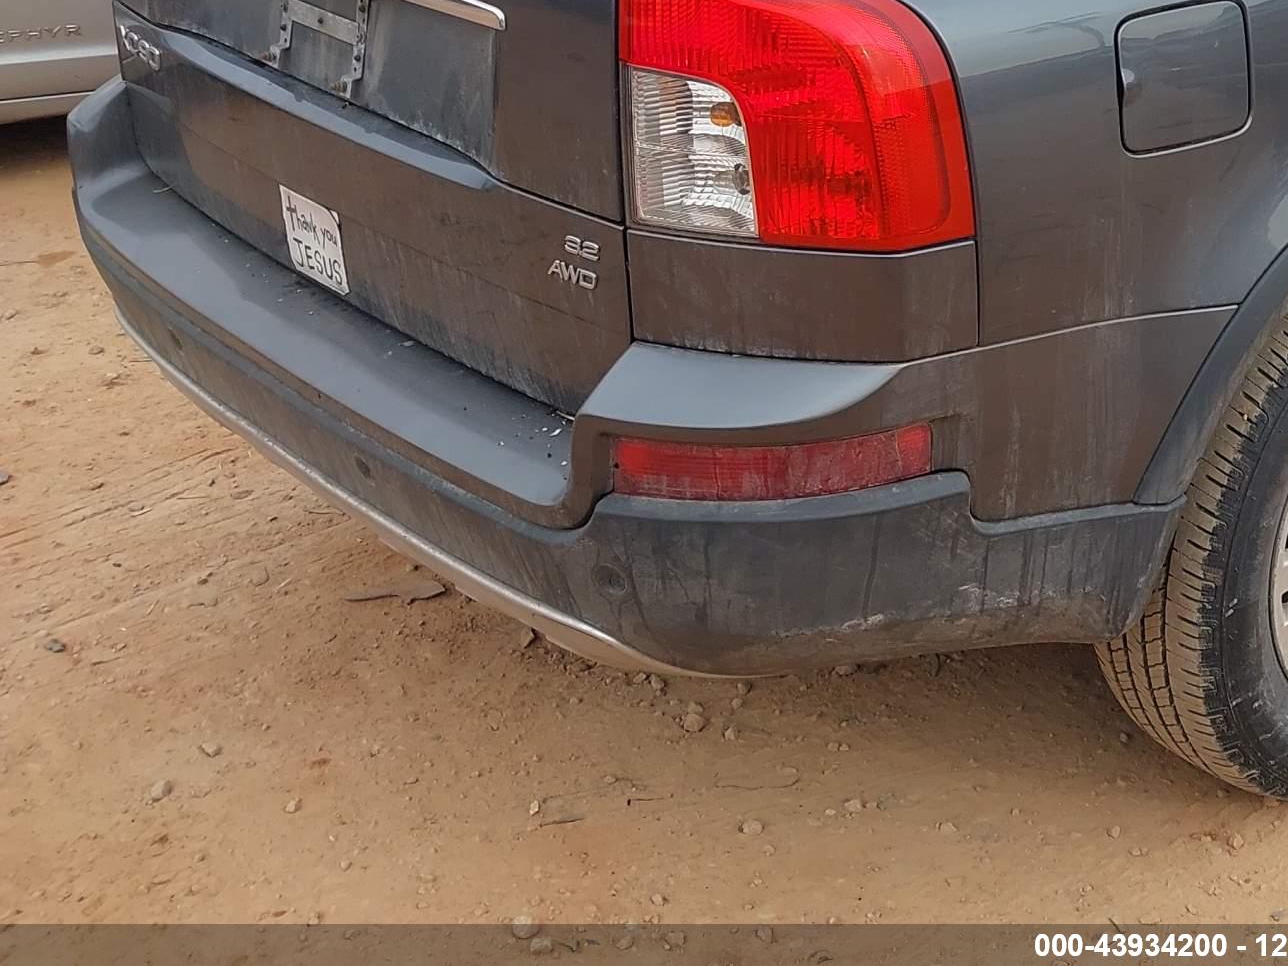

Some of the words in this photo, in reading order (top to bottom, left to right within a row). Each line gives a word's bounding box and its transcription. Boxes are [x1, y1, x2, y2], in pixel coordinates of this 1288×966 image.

[292, 237, 343, 286] JESUS
[564, 234, 600, 262] 3.2
[547, 259, 597, 290] AWD
